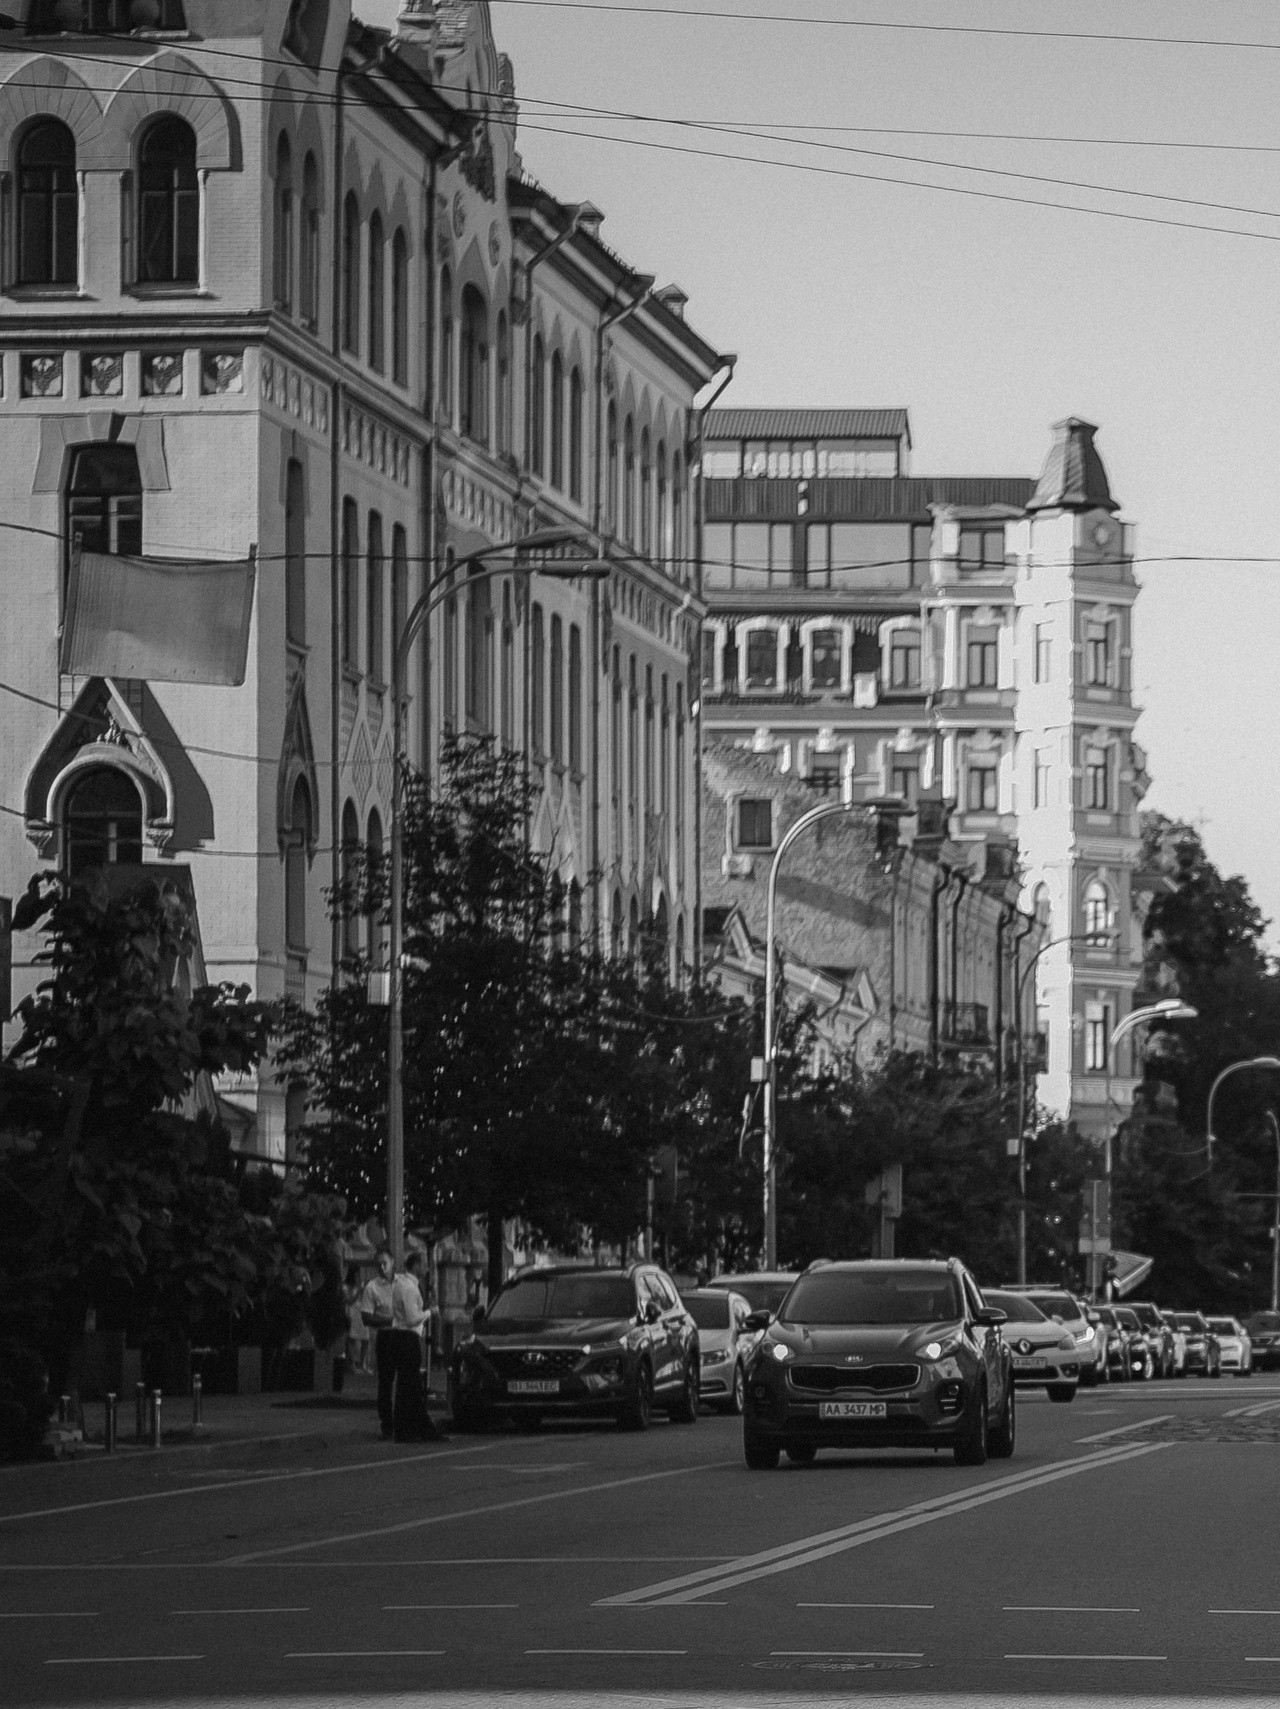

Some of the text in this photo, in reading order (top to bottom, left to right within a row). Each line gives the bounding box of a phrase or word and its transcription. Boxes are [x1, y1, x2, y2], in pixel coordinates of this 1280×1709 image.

[826, 1404, 885, 1415] AA 3437 MP
